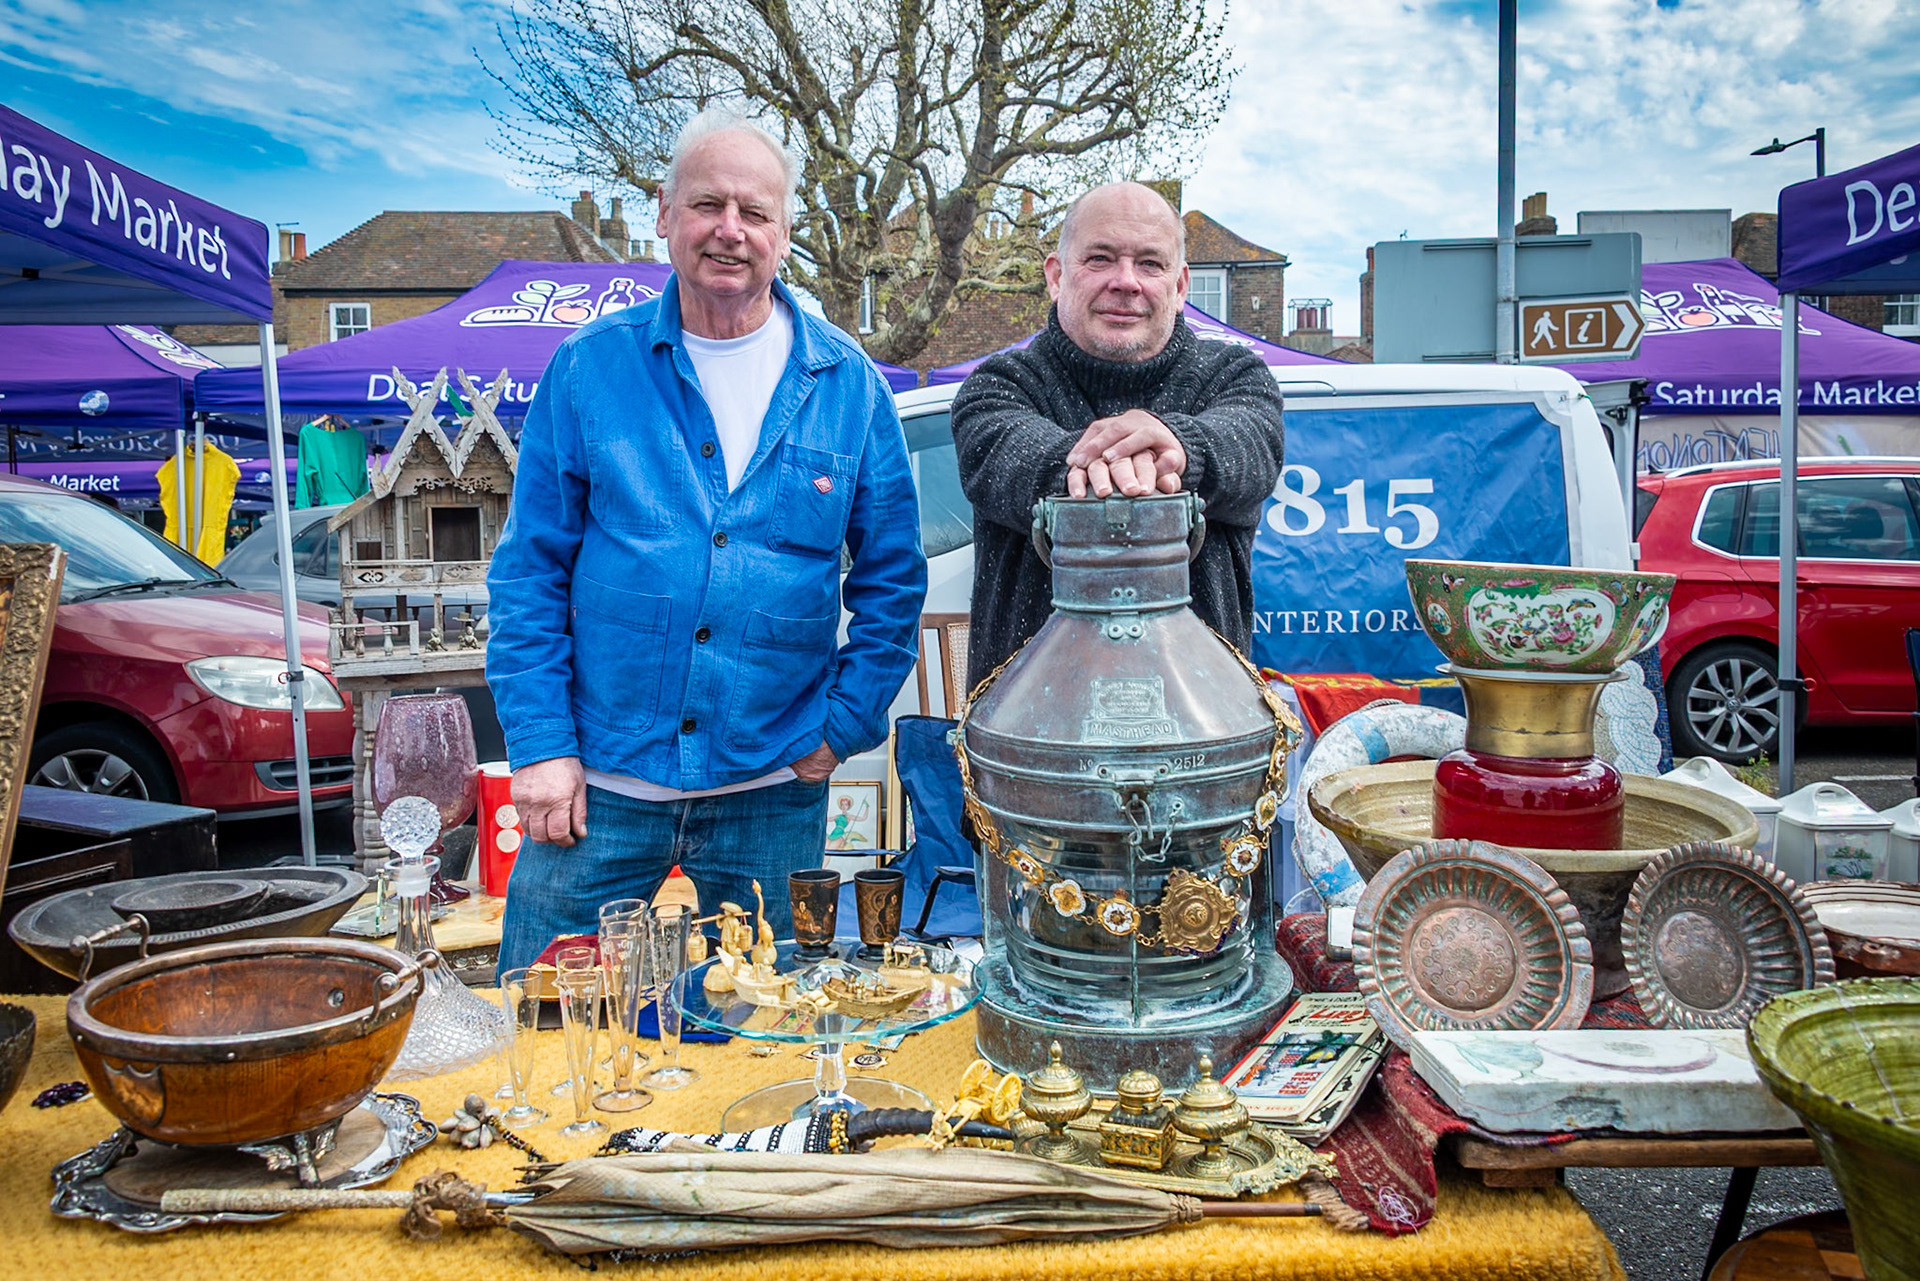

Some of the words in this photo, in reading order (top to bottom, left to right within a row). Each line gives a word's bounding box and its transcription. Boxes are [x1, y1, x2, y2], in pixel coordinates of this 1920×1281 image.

[84, 159, 232, 280] Market
[1845, 180, 1920, 246] De
[1655, 381, 1802, 406] Saturda
[51, 474, 120, 491] Market
[1255, 464, 1440, 550] 815
[1252, 609, 1423, 634] NTERIOR
[1090, 722, 1172, 740] MASTHEAD
[1174, 753, 1206, 771] 2512
